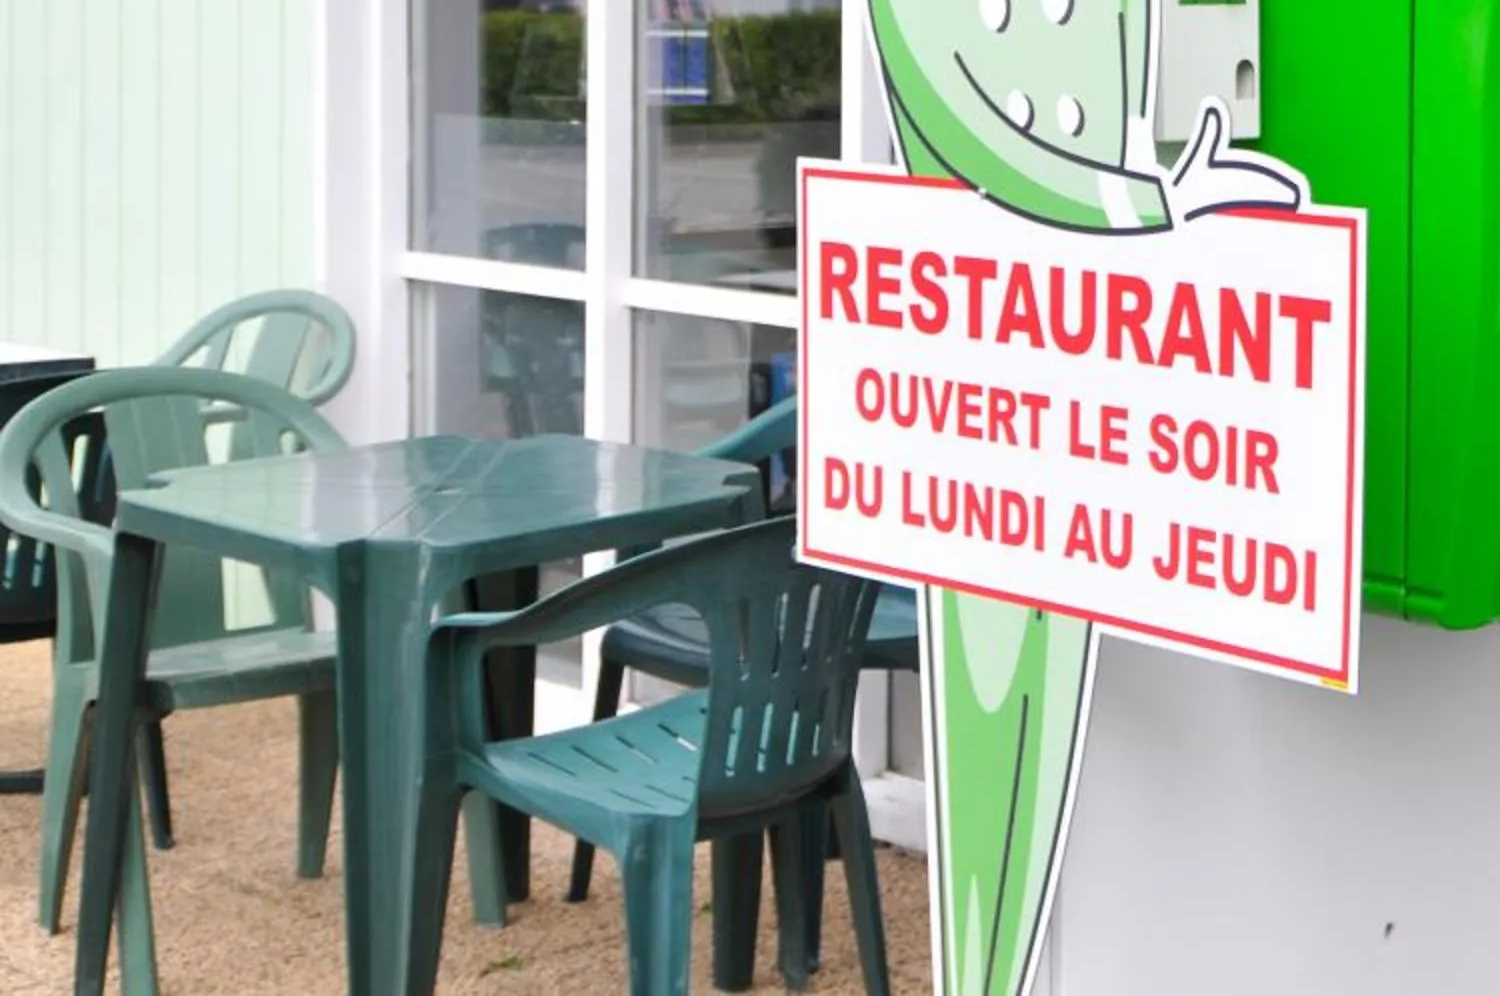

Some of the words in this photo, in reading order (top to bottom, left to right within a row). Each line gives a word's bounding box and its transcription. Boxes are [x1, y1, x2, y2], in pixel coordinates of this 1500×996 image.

[820, 241, 1332, 390] RESTAURANT
[855, 367, 1050, 450] OUVERT
[1069, 400, 1129, 465] LE
[1148, 414, 1280, 495] SOIR
[823, 457, 883, 518] DU
[901, 471, 1045, 551] LUNDI
[1064, 504, 1133, 570] AU
[1152, 522, 1317, 613] JEUDI
